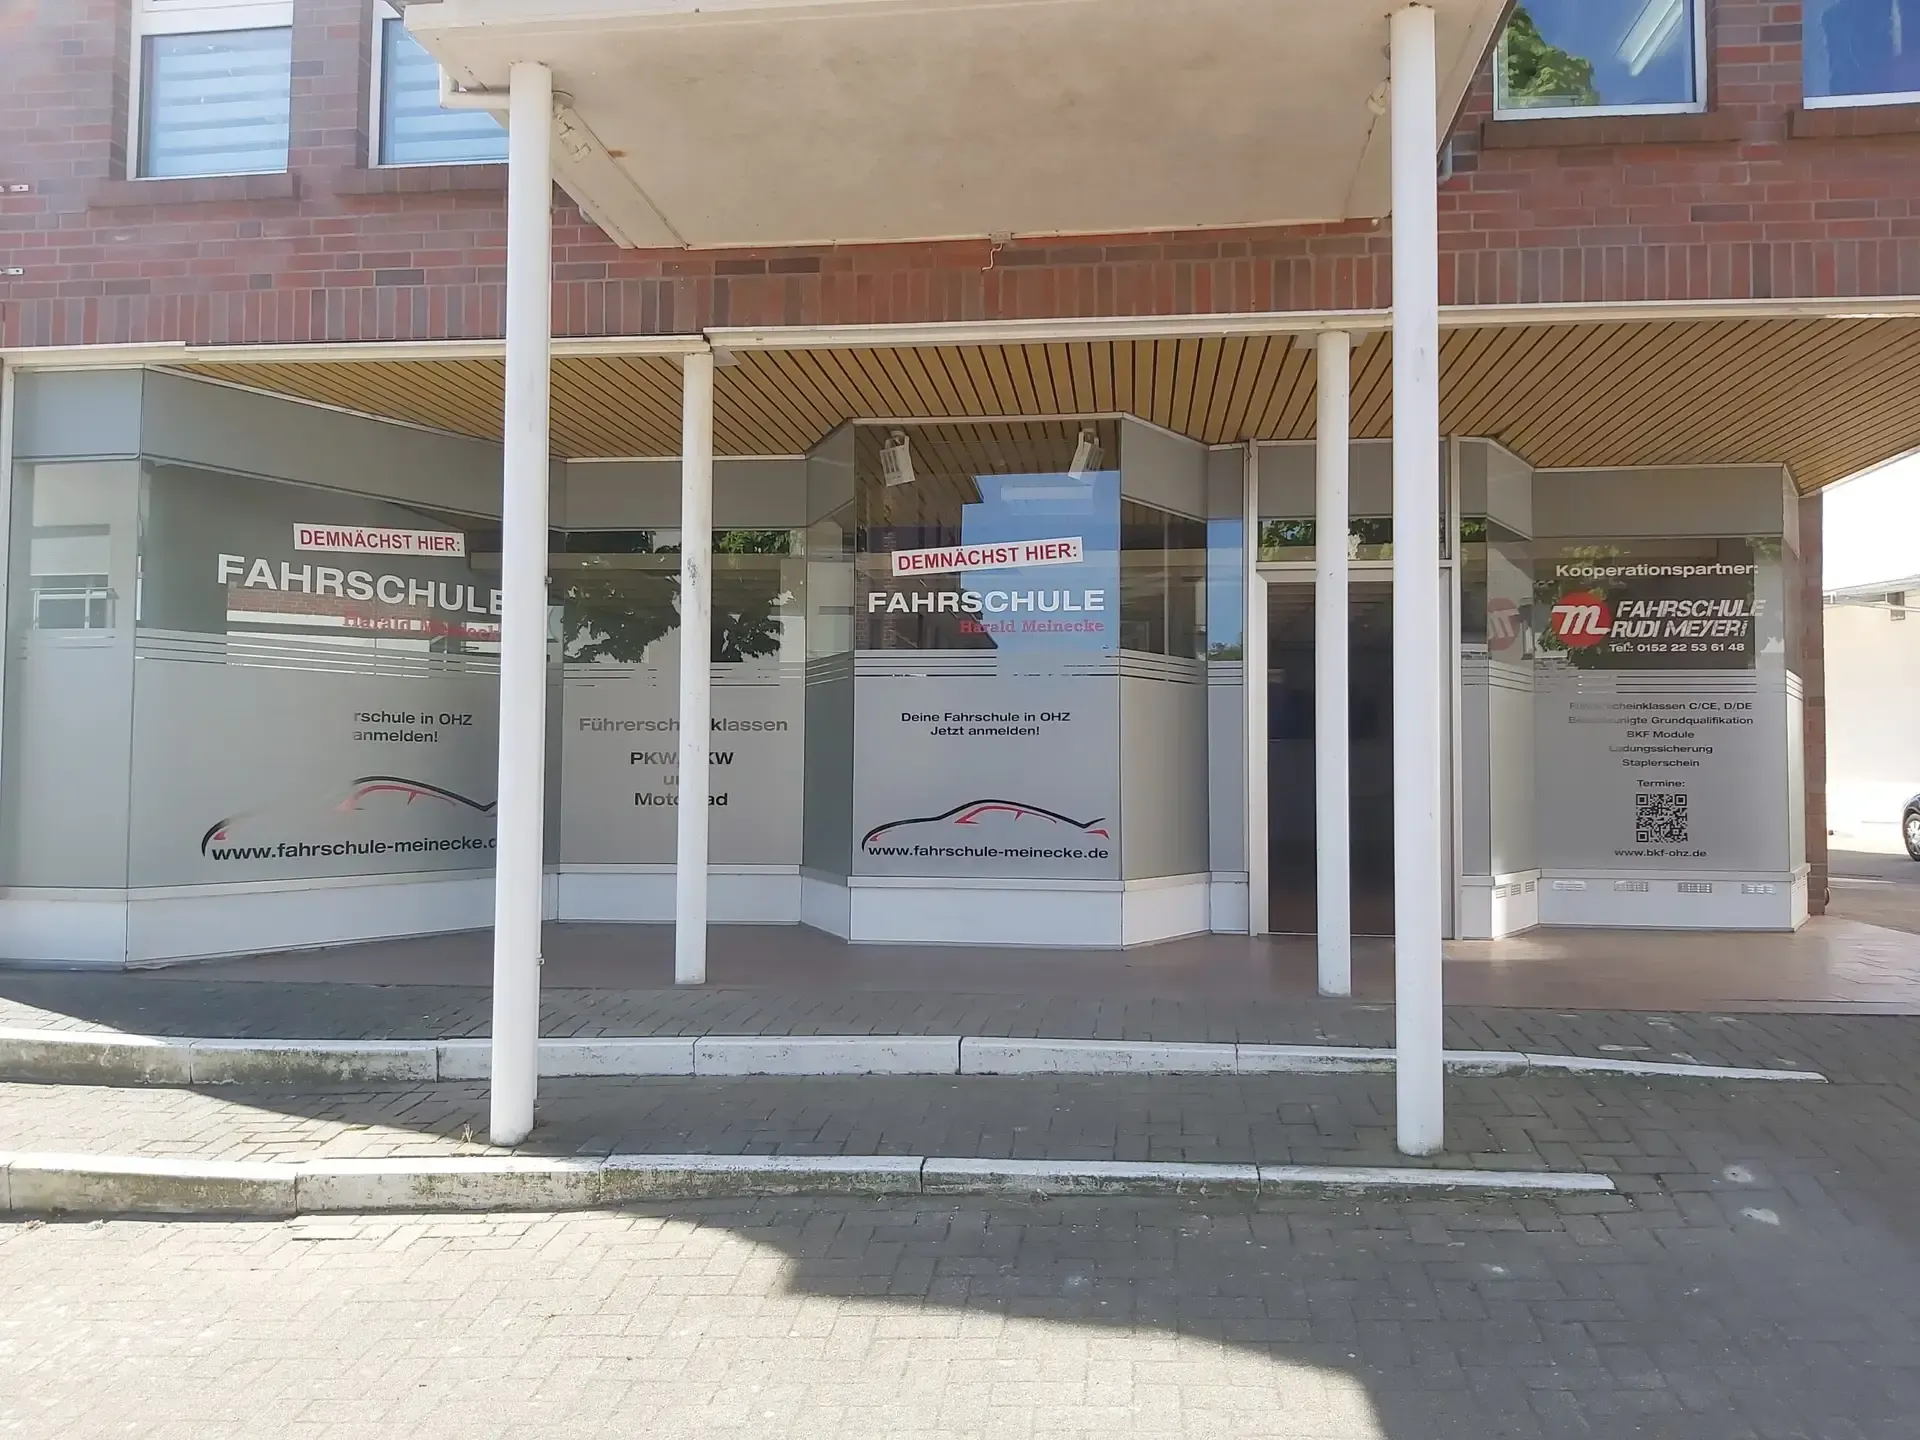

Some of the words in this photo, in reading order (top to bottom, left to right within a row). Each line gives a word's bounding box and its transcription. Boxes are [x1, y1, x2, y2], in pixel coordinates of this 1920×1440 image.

[300, 529, 412, 549] DEMNÄCHST
[418, 534, 461, 552] HIER:
[898, 547, 1019, 571] DEMNÄCHST
[1026, 543, 1077, 561] HIER:
[1556, 563, 1758, 579] Kooperationspartner:
[217, 553, 502, 615] FAHRSCHULE
[868, 589, 1105, 613] FAHRSCHULE
[1616, 600, 1766, 618] FAHRSCHULE
[960, 619, 1016, 633] Harald
[1022, 619, 1105, 632] Meinecke
[1610, 620, 1660, 638] RUDI
[1664, 620, 1740, 638] MEYER
[1637, 643, 1667, 652] 0152
[1671, 643, 1687, 652] 22
[1691, 643, 1707, 652] 53
[1710, 643, 1724, 652] 61
[1728, 643, 1745, 652] 48
[1689, 702, 1721, 712] C/CE,
[1724, 702, 1753, 710] D/DE
[420, 712, 434, 724] in
[439, 713, 473, 725] OHZ
[901, 712, 940, 723] Deine
[944, 712, 1020, 723] Fahrschule
[1024, 712, 1036, 723] in
[1040, 712, 1071, 723] OHZ
[1651, 716, 1753, 726] Grundqualifikation
[579, 718, 788, 731] Führerschklassen
[930, 726, 964, 736] Jetzt
[968, 726, 1040, 736] anmelden!
[354, 729, 438, 743] anmelden!
[1627, 730, 1650, 738] BKF
[1653, 730, 1695, 739] Module
[1622, 759, 1700, 768] Staplerschein
[1637, 780, 1685, 788] Termine:
[868, 845, 1109, 859] www.fahrschule-meinecke.de
[1614, 849, 1707, 857] www.bkf-ohz.de
